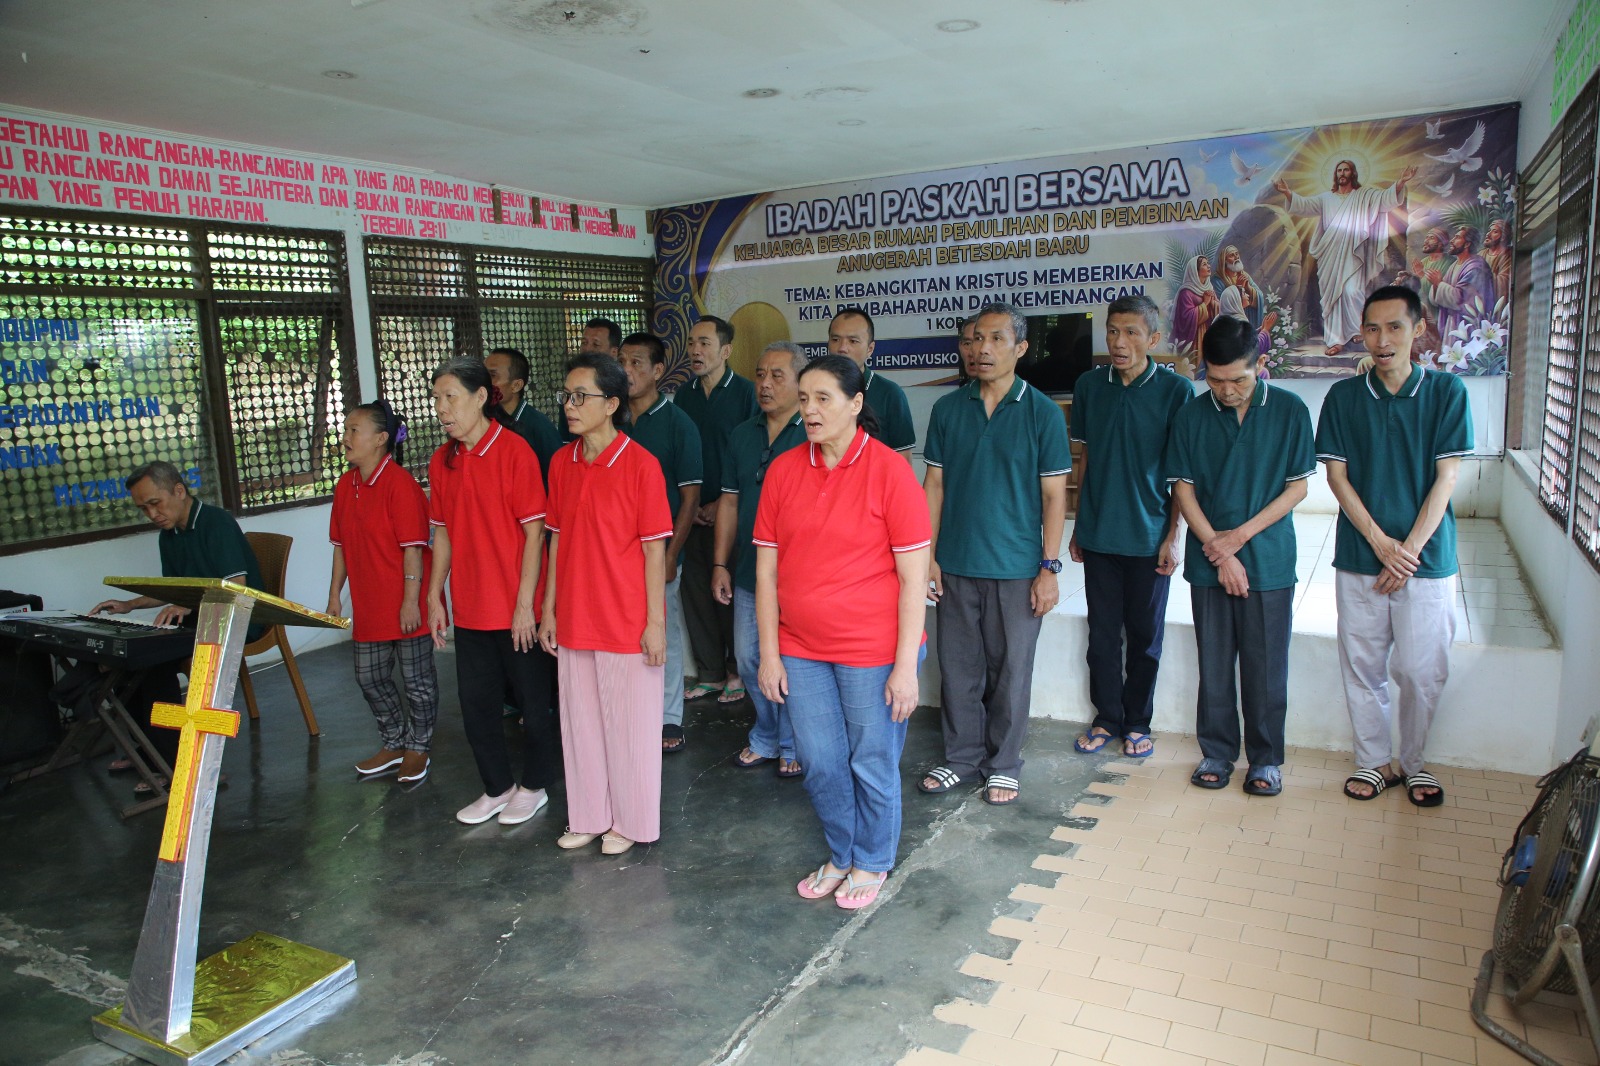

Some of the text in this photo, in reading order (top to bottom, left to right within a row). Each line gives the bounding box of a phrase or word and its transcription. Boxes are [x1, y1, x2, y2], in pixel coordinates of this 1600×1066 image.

[0, 116, 90, 152] GETAHUI
[98, 131, 315, 182] RANCANGAN-RANCANGAN
[321, 164, 349, 186] APA
[353, 168, 387, 190] YANG
[392, 174, 417, 195] ADA
[420, 178, 469, 202] PADA-KU
[473, 186, 523, 208] MENENAI
[0, 173, 269, 223] PAN YANG PENUH HARAPAN.
[22, 148, 151, 187] RANCANGAN
[158, 166, 212, 193] DAMAI
[219, 174, 315, 205] SEJAHTERA
[318, 187, 349, 209] DAN
[355, 191, 399, 213] BUKAN
[405, 197, 476, 222] RANCANGAN
[766, 157, 1191, 238] IBADAH PASKAH BERSAMA
[360, 214, 447, 240] YEREMIA 29:11
[734, 197, 1230, 262] KELUARGA BESAR RUMAH PEMULIHAN DAN PEMBINAAN
[837, 234, 1090, 274] ANUGERAH BETESDAH BARU
[785, 261, 1164, 304] TEMA: KEBANGKITAN KRISTUS MEMBERIKAN
[799, 304, 833, 322] KITA
[1010, 285, 1146, 309] KEMENANGAN
[926, 317, 932, 331] 1
[1, 359, 49, 384] DAN
[875, 352, 960, 367] HENDRYUSKO
[120, 396, 161, 420] DAN
[54, 476, 131, 507] MAZMU
